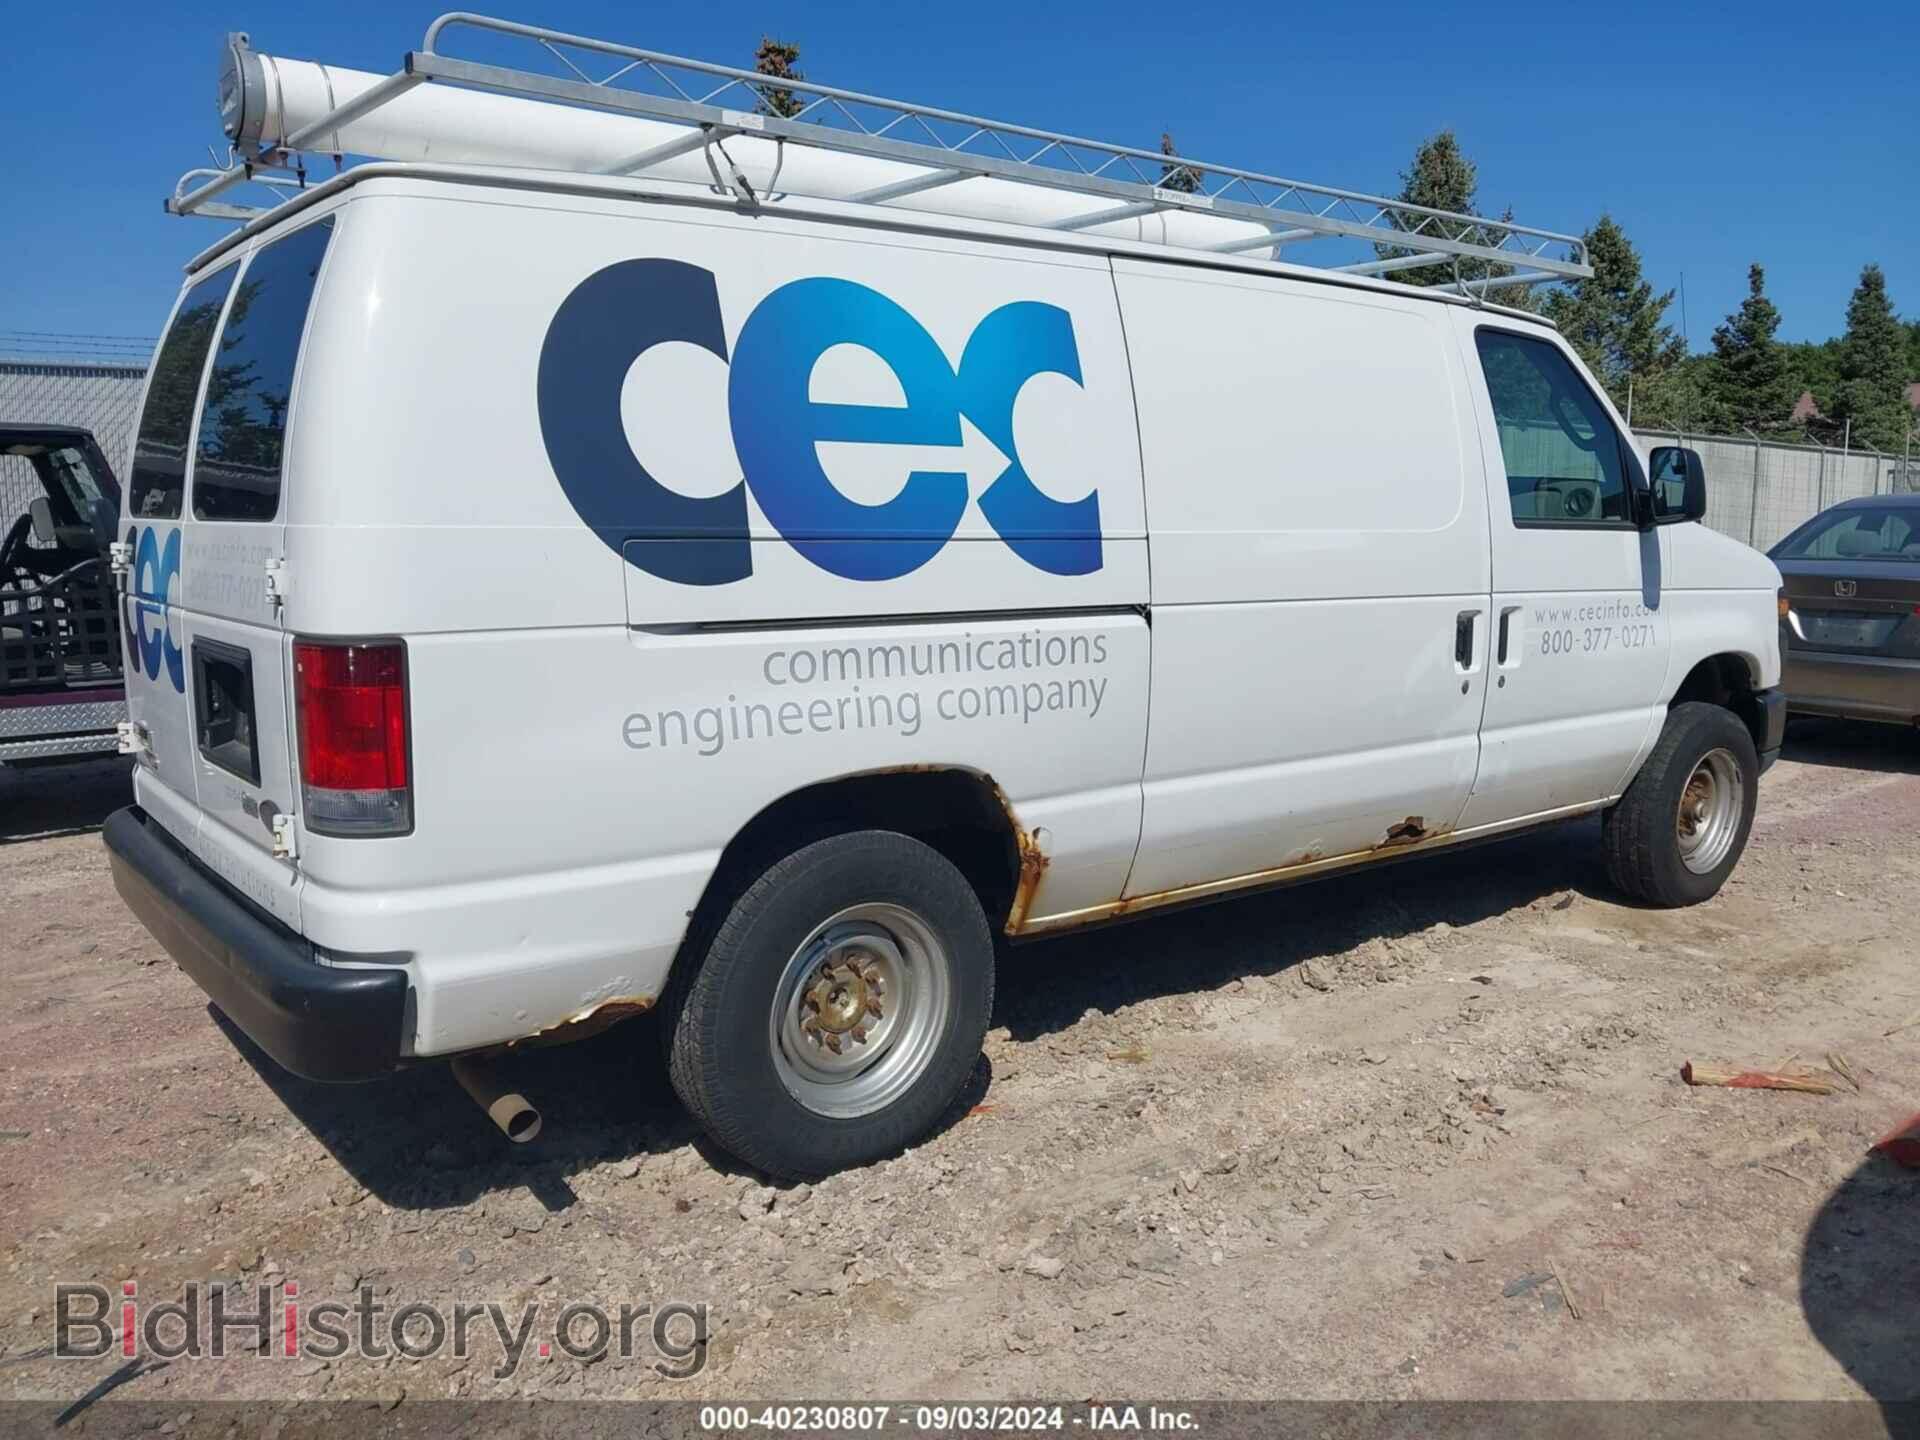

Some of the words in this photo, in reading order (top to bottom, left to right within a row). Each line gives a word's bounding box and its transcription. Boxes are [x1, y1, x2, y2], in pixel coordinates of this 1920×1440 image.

[537, 257, 1103, 587] cec
[763, 629, 1108, 685] communications
[1541, 625, 1657, 654] 800-377-0271
[622, 686, 922, 756] engineering
[937, 677, 1108, 723] company
